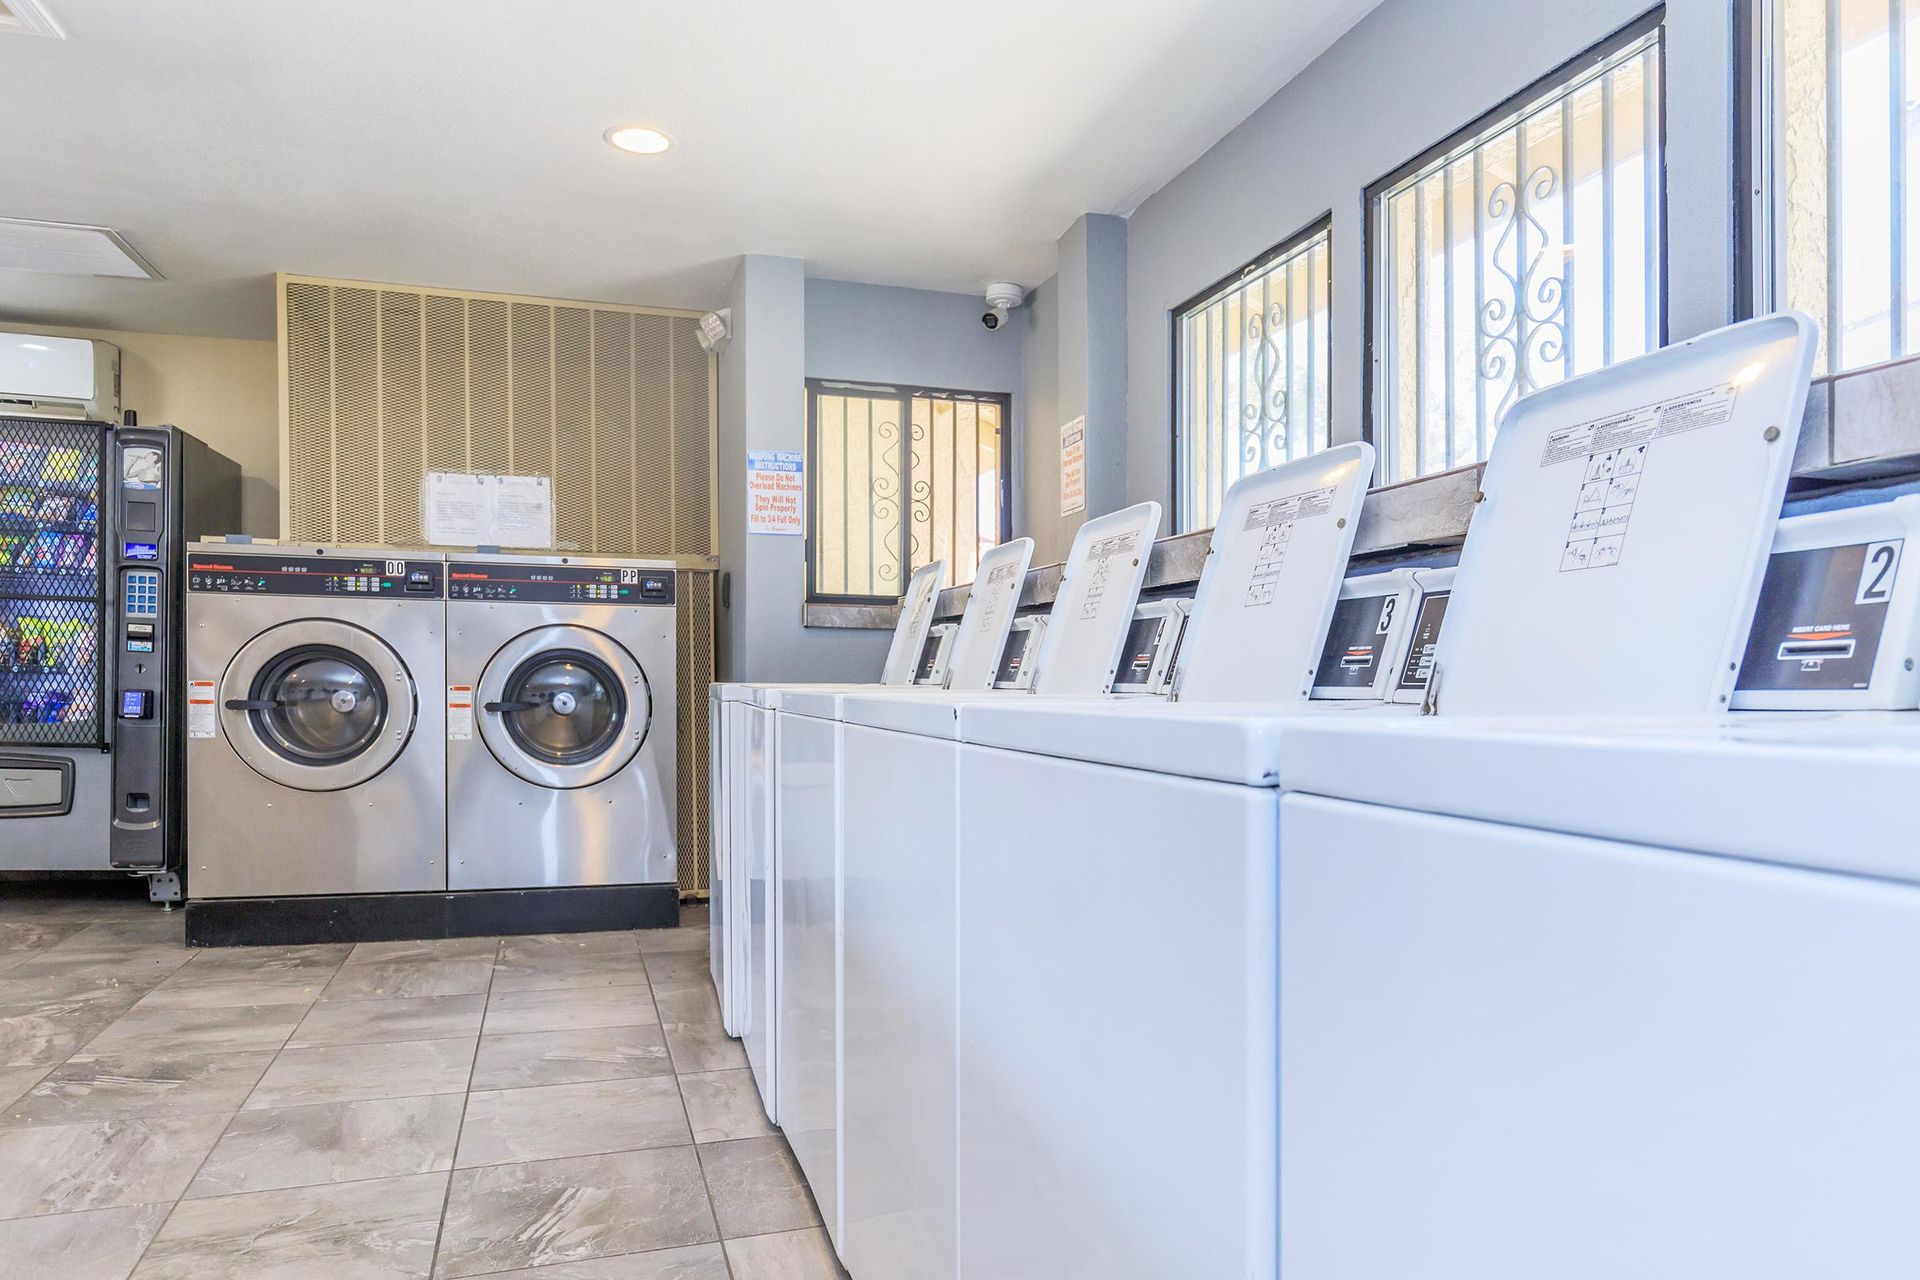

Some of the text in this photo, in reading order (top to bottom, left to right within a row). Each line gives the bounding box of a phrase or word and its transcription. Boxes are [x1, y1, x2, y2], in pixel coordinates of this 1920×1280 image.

[756, 472, 795, 482] Please Do Not
[750, 481, 801, 491] Overload Machines
[755, 495, 770, 504] They
[785, 496, 796, 504] Not
[755, 503, 796, 514] Spin Properly
[751, 514, 759, 522] Fill
[777, 515, 787, 523] Full
[788, 516, 800, 526] Only
[622, 570, 637, 583] PP
[1863, 546, 1895, 600] 2
[1380, 598, 1396, 632] 3
